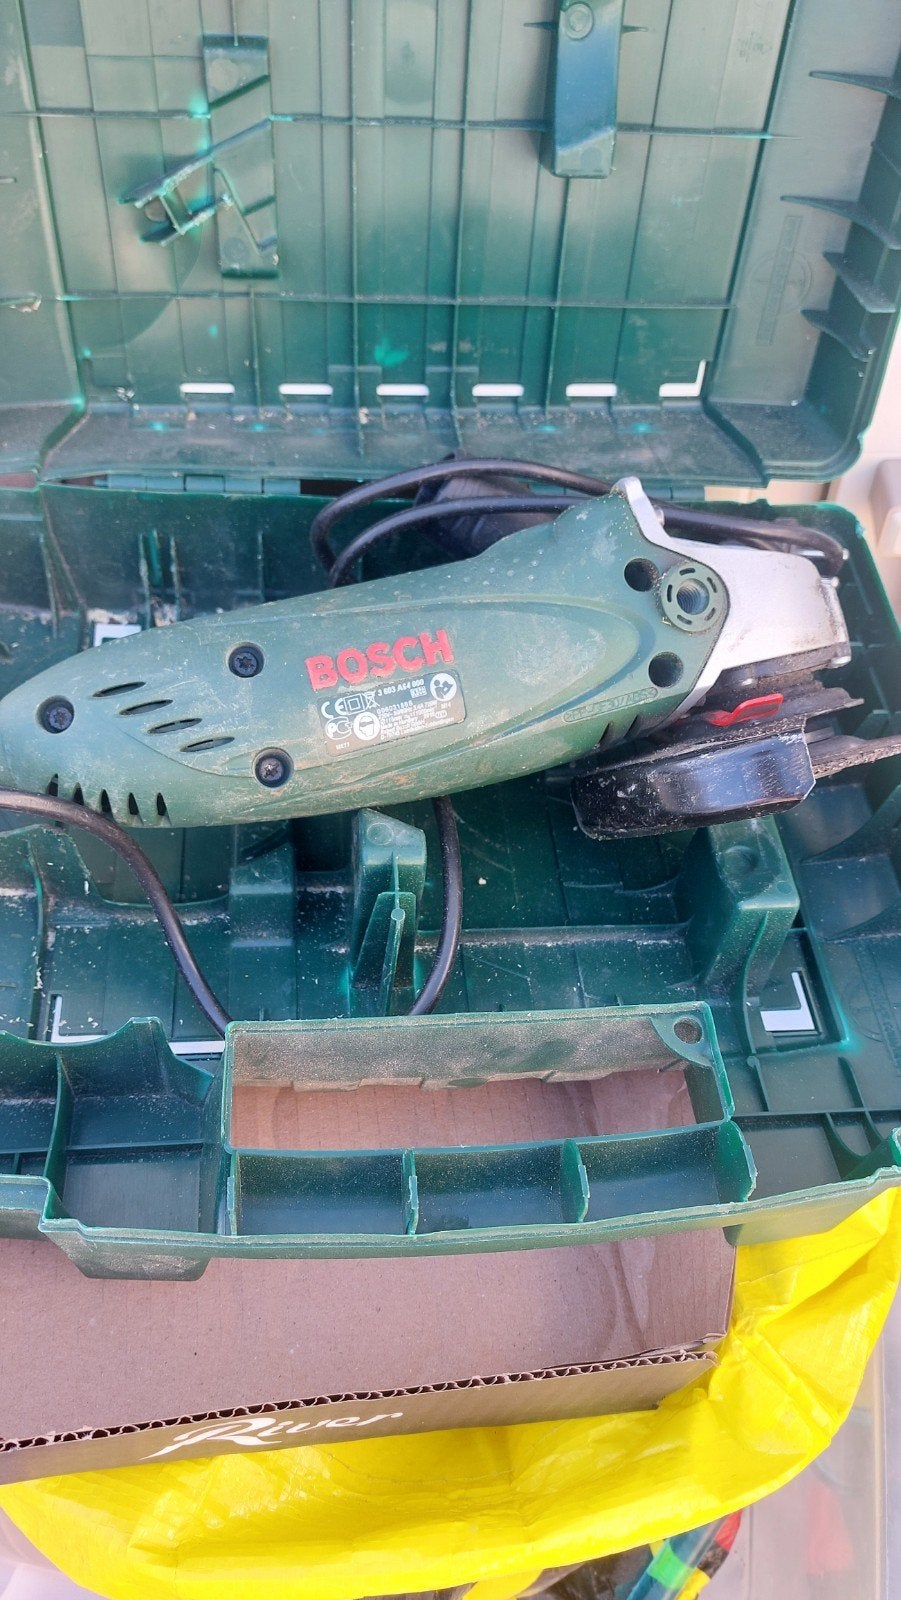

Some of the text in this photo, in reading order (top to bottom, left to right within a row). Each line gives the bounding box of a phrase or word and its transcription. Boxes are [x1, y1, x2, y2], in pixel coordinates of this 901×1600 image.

[305, 629, 454, 690] BOSCH
[377, 689, 383, 697] 3
[138, 1412, 403, 1460] River
